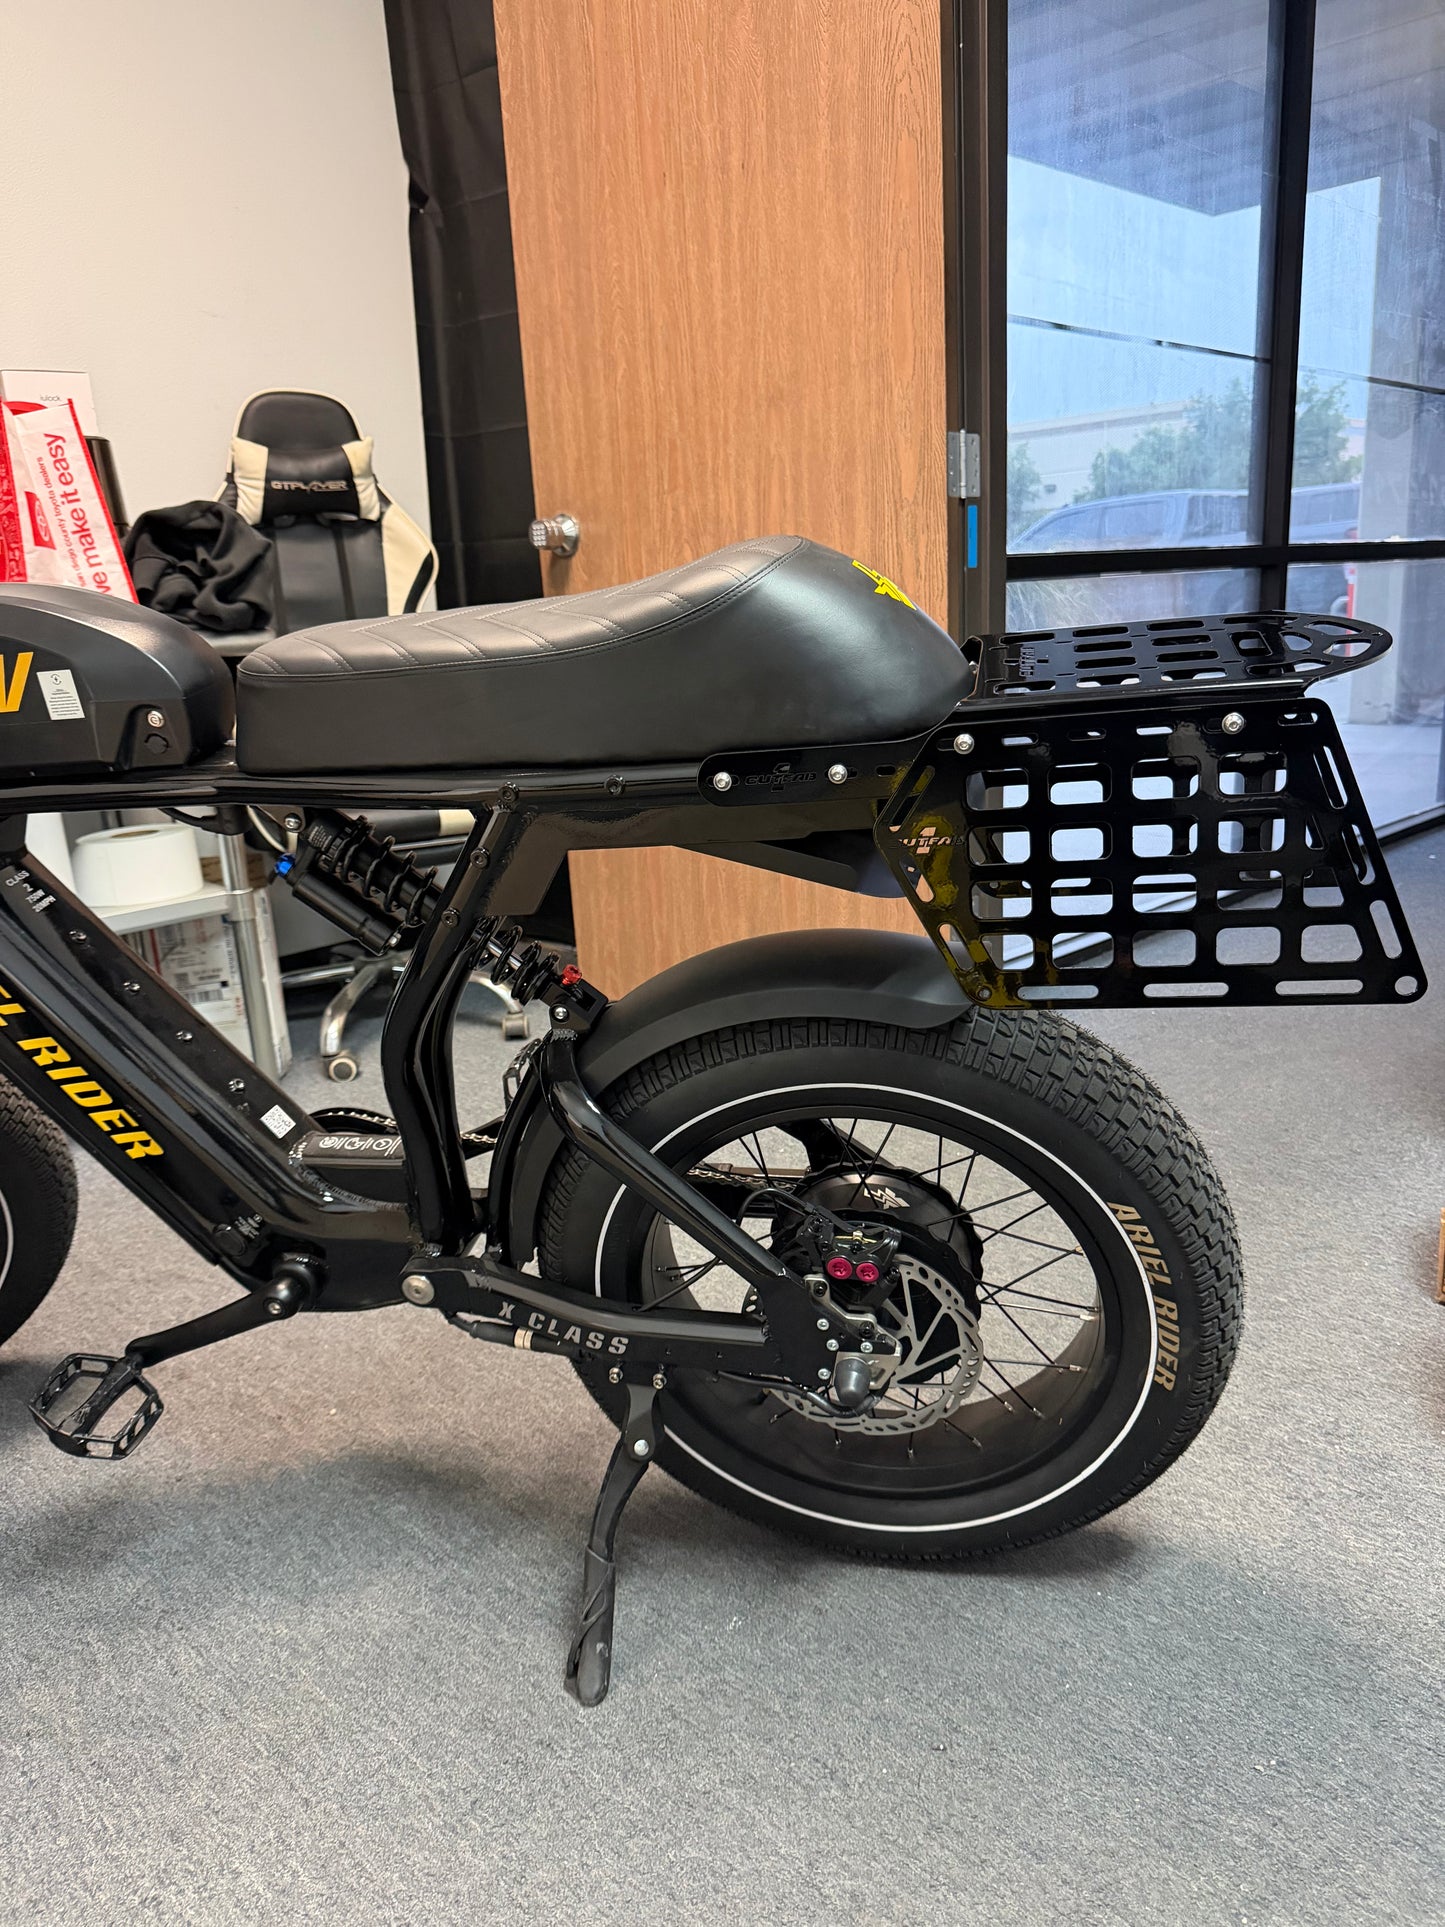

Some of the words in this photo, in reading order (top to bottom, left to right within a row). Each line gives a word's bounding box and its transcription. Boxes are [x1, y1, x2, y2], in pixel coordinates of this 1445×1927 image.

[36, 456, 53, 489] dealers
[43, 433, 75, 486] easy
[47, 489, 63, 517] toyota
[60, 488, 81, 506] it
[57, 517, 73, 547] county
[69, 507, 103, 569] make
[22, 883, 34, 892] 2
[17, 1036, 164, 1160] RIDER
[1107, 1202, 1173, 1285] ARIEL
[1153, 1296, 1180, 1392] RIDER
[498, 1301, 516, 1320] X
[528, 1311, 630, 1355] CLASS
